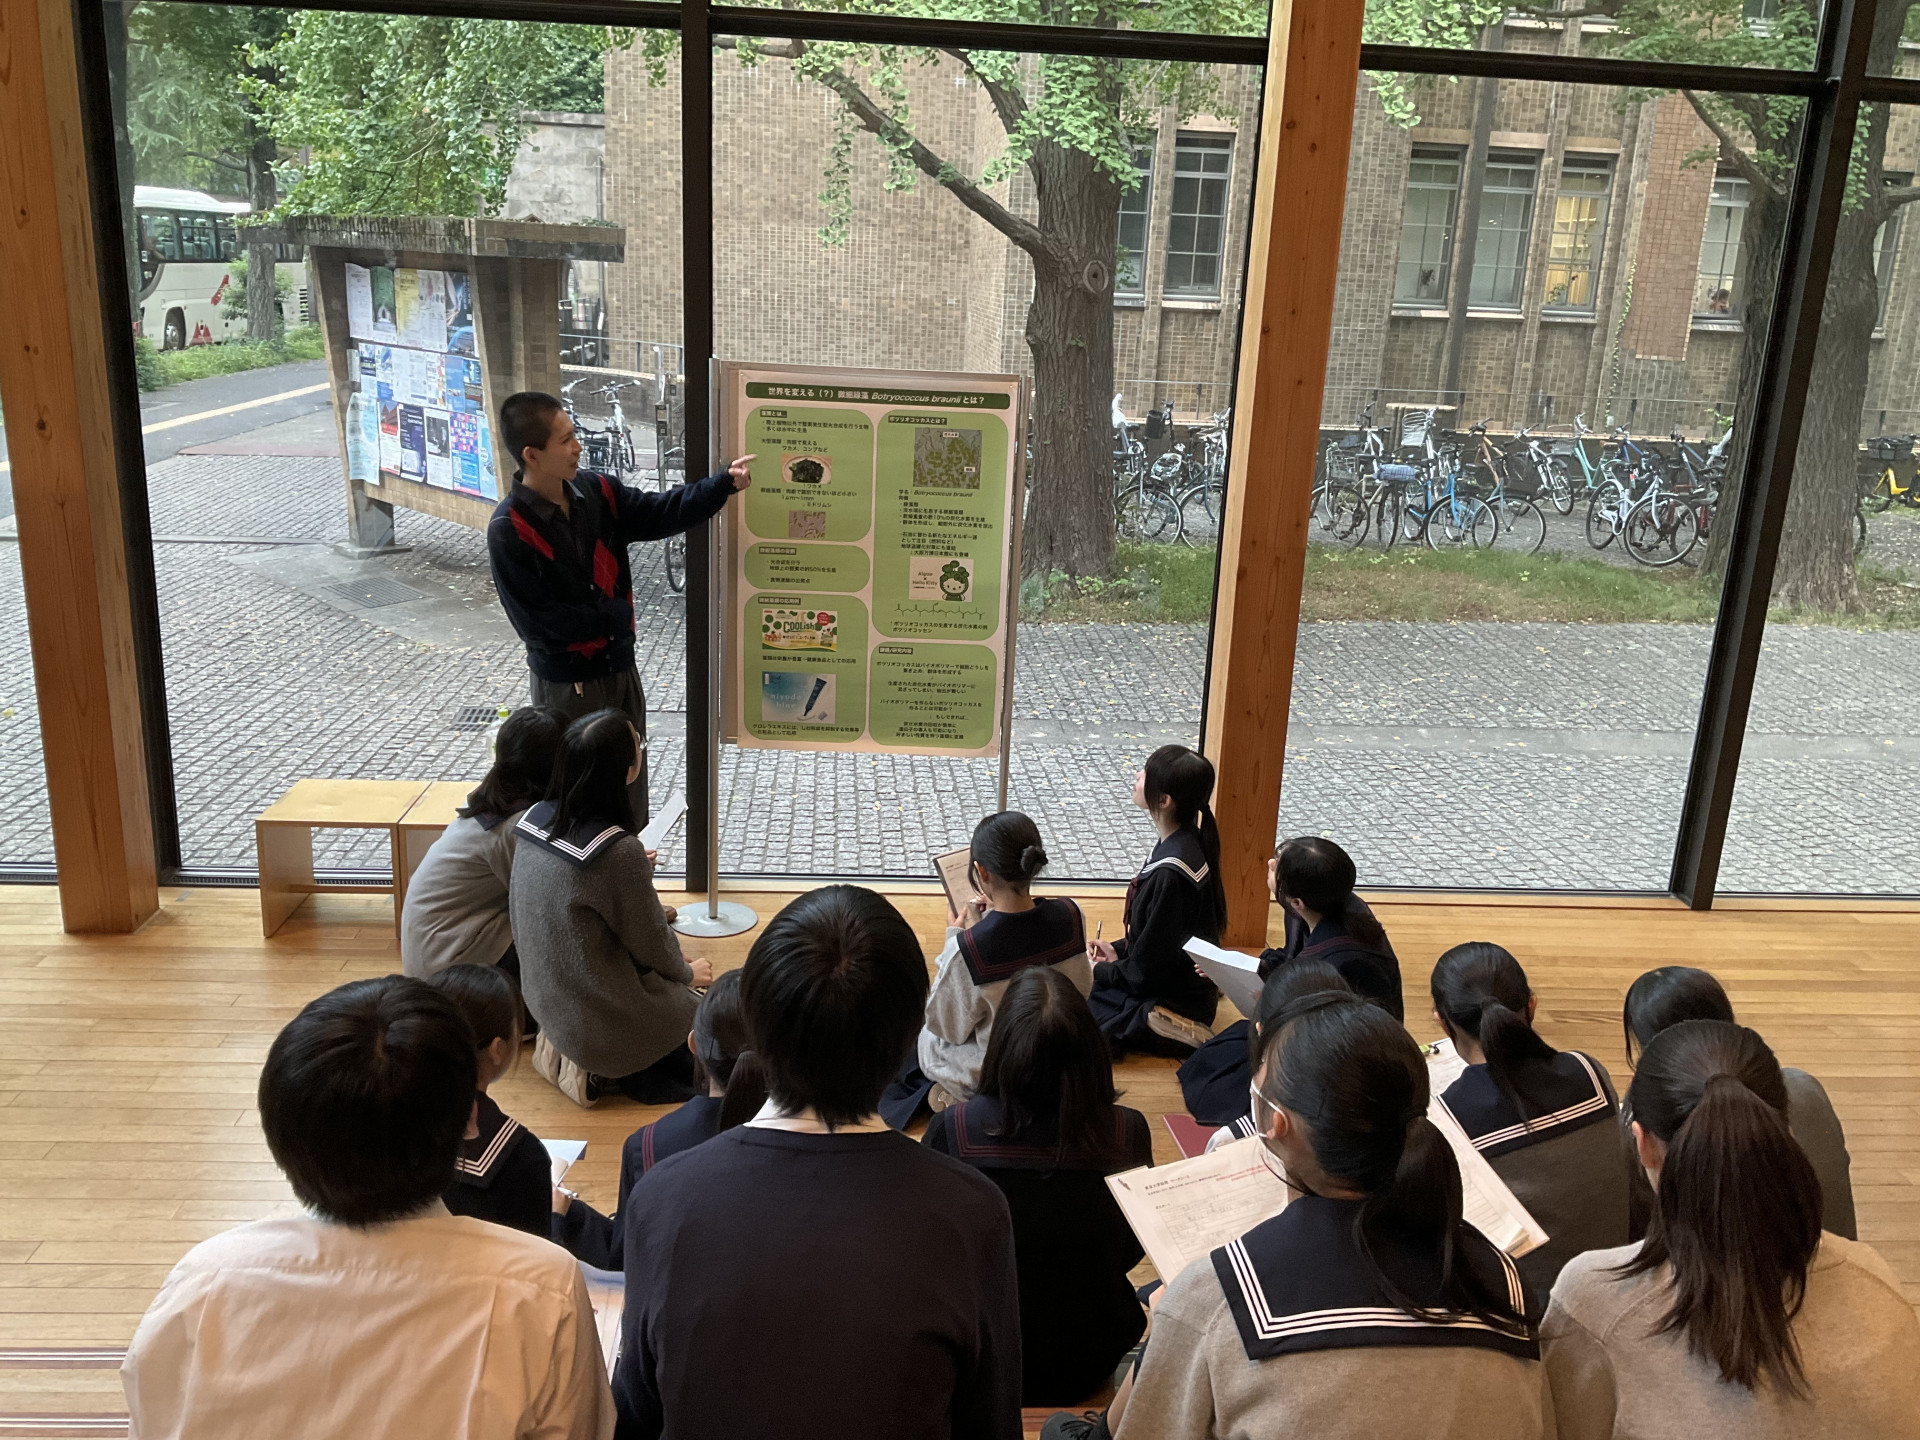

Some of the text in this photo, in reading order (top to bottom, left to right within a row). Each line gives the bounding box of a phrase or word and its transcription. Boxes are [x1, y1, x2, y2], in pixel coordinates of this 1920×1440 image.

[871, 392, 929, 402] Botryococcus
[931, 394, 961, 403] braunii
[962, 395, 985, 405] とは？
